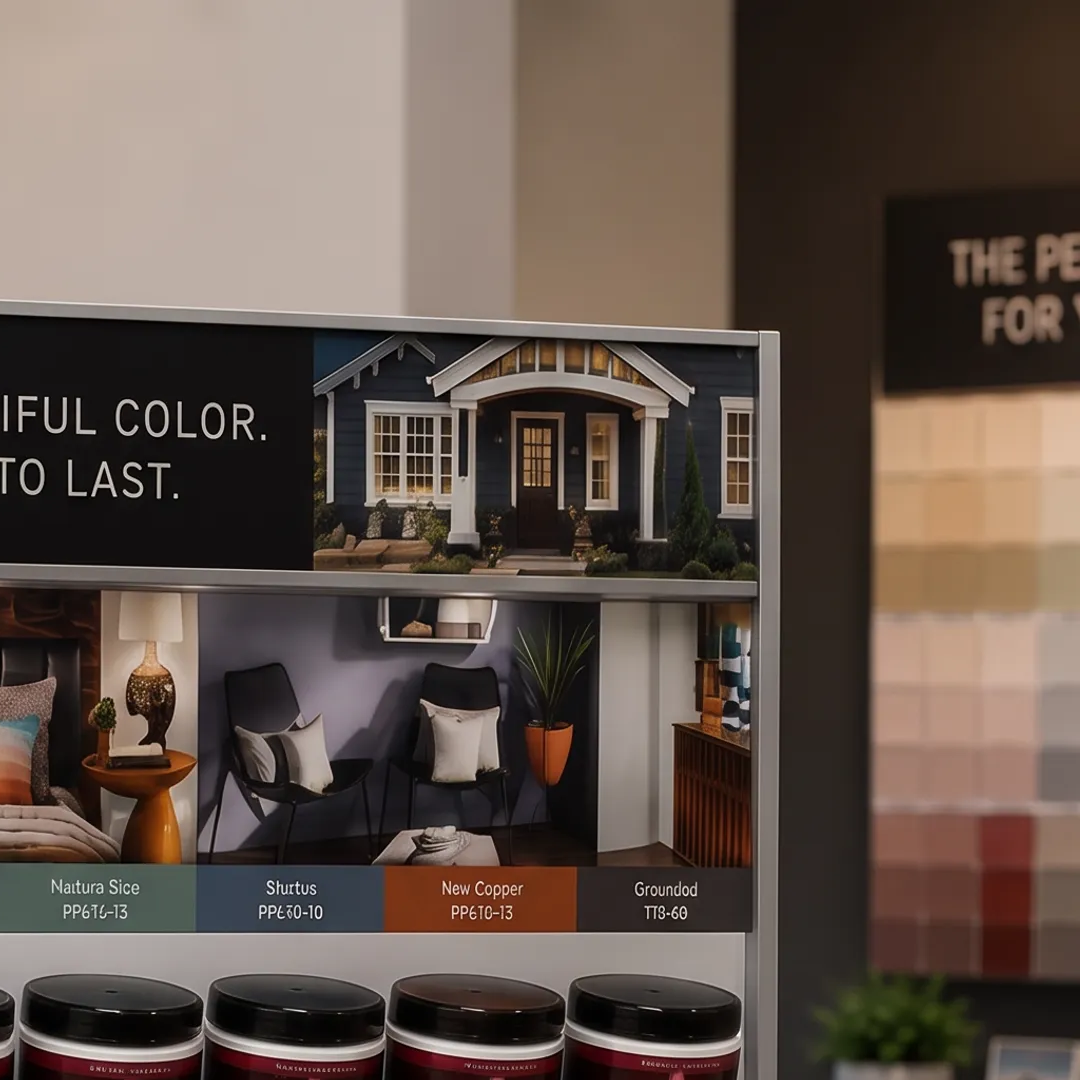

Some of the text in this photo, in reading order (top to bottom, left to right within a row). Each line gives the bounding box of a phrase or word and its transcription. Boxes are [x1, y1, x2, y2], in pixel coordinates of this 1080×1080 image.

[947, 236, 1027, 287] THE
[982, 294, 1064, 345] FOR
[115, 398, 268, 441] COLOR.
[67, 459, 179, 500] LAST.
[109, 878, 140, 895] Sice
[441, 880, 524, 900] New Copper
